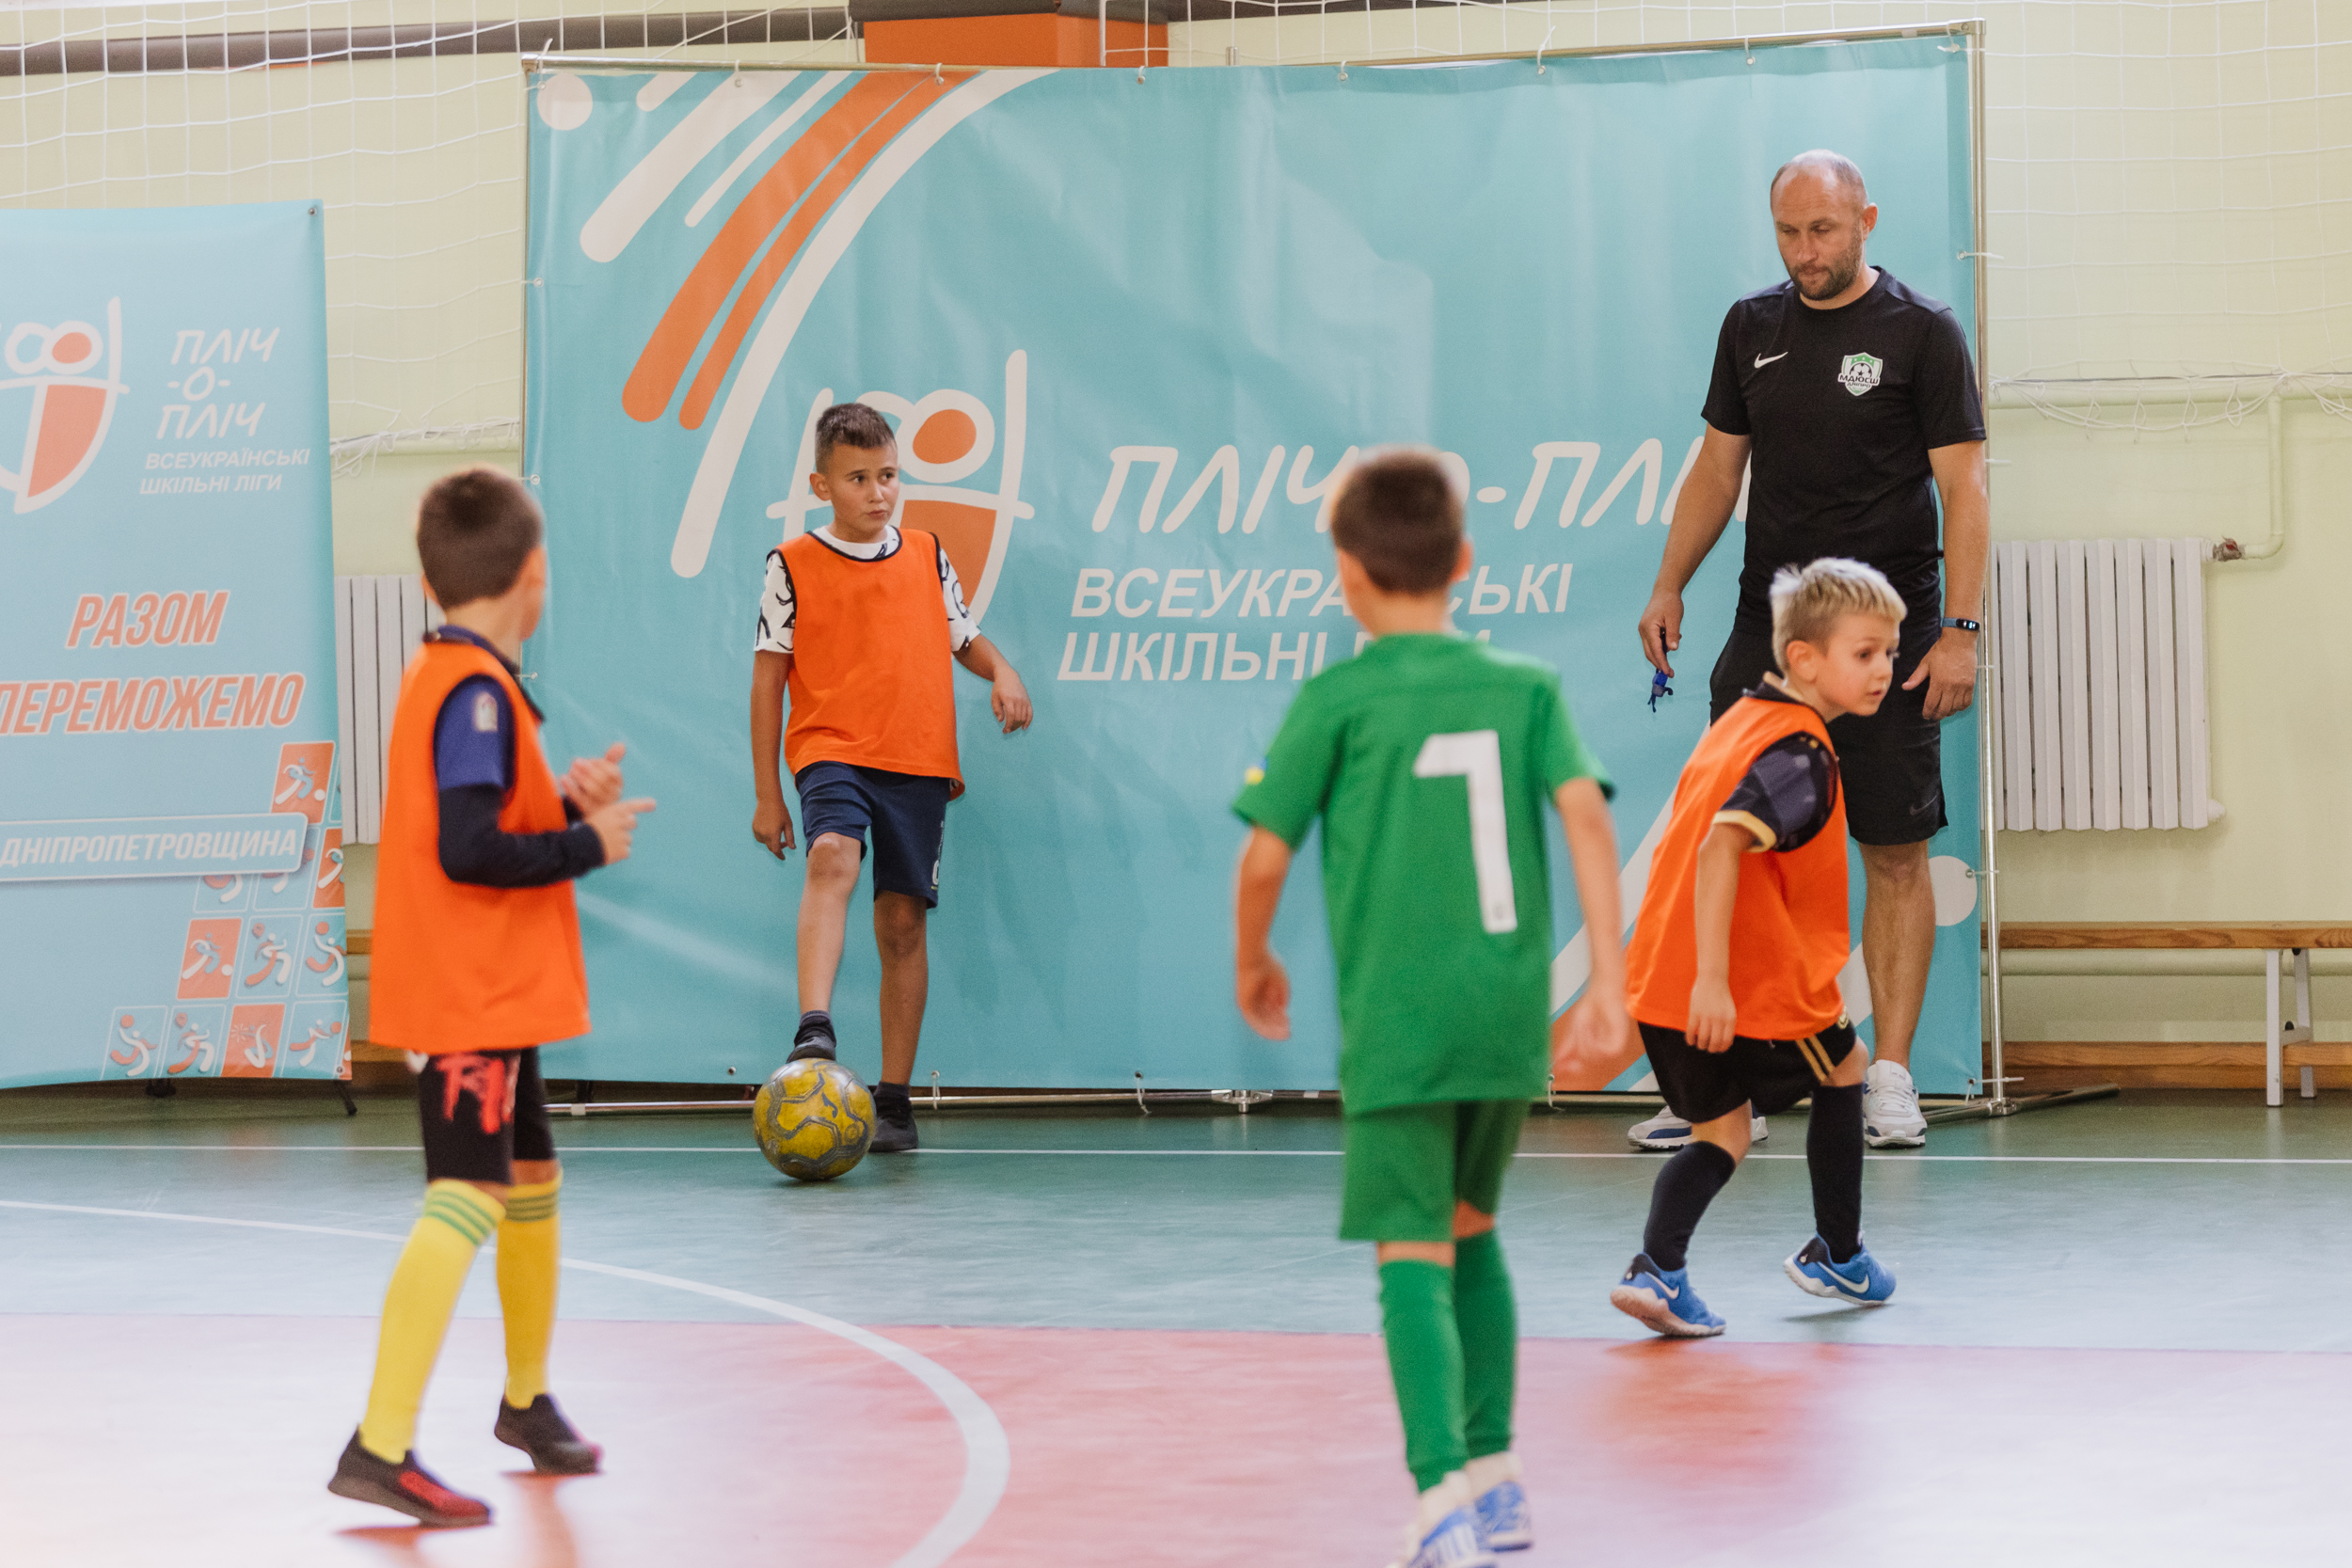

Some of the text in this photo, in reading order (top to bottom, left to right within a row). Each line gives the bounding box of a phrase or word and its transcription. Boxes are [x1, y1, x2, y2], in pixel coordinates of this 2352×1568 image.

[170, 327, 280, 365] ПЛІЧ
[1839, 374, 1880, 385] МДЮСШ
[156, 402, 266, 439] ПЛІЧ
[145, 448, 310, 469] ВСЕУКРАЇНСЬКІ
[139, 473, 282, 495] ШКІЛЬНІ ЛІГИ
[1071, 563, 1573, 618] ВСЕУКРАЬКІ
[66, 590, 230, 649] РАЗОМ
[1057, 632, 1328, 681] ШКІЛЬНІ
[0, 672, 306, 736] ПЕРЕМОЖЕМО
[0, 829, 296, 868] ДНІПРОПЕТРОВЩИНА
[1413, 729, 1518, 934] 1
